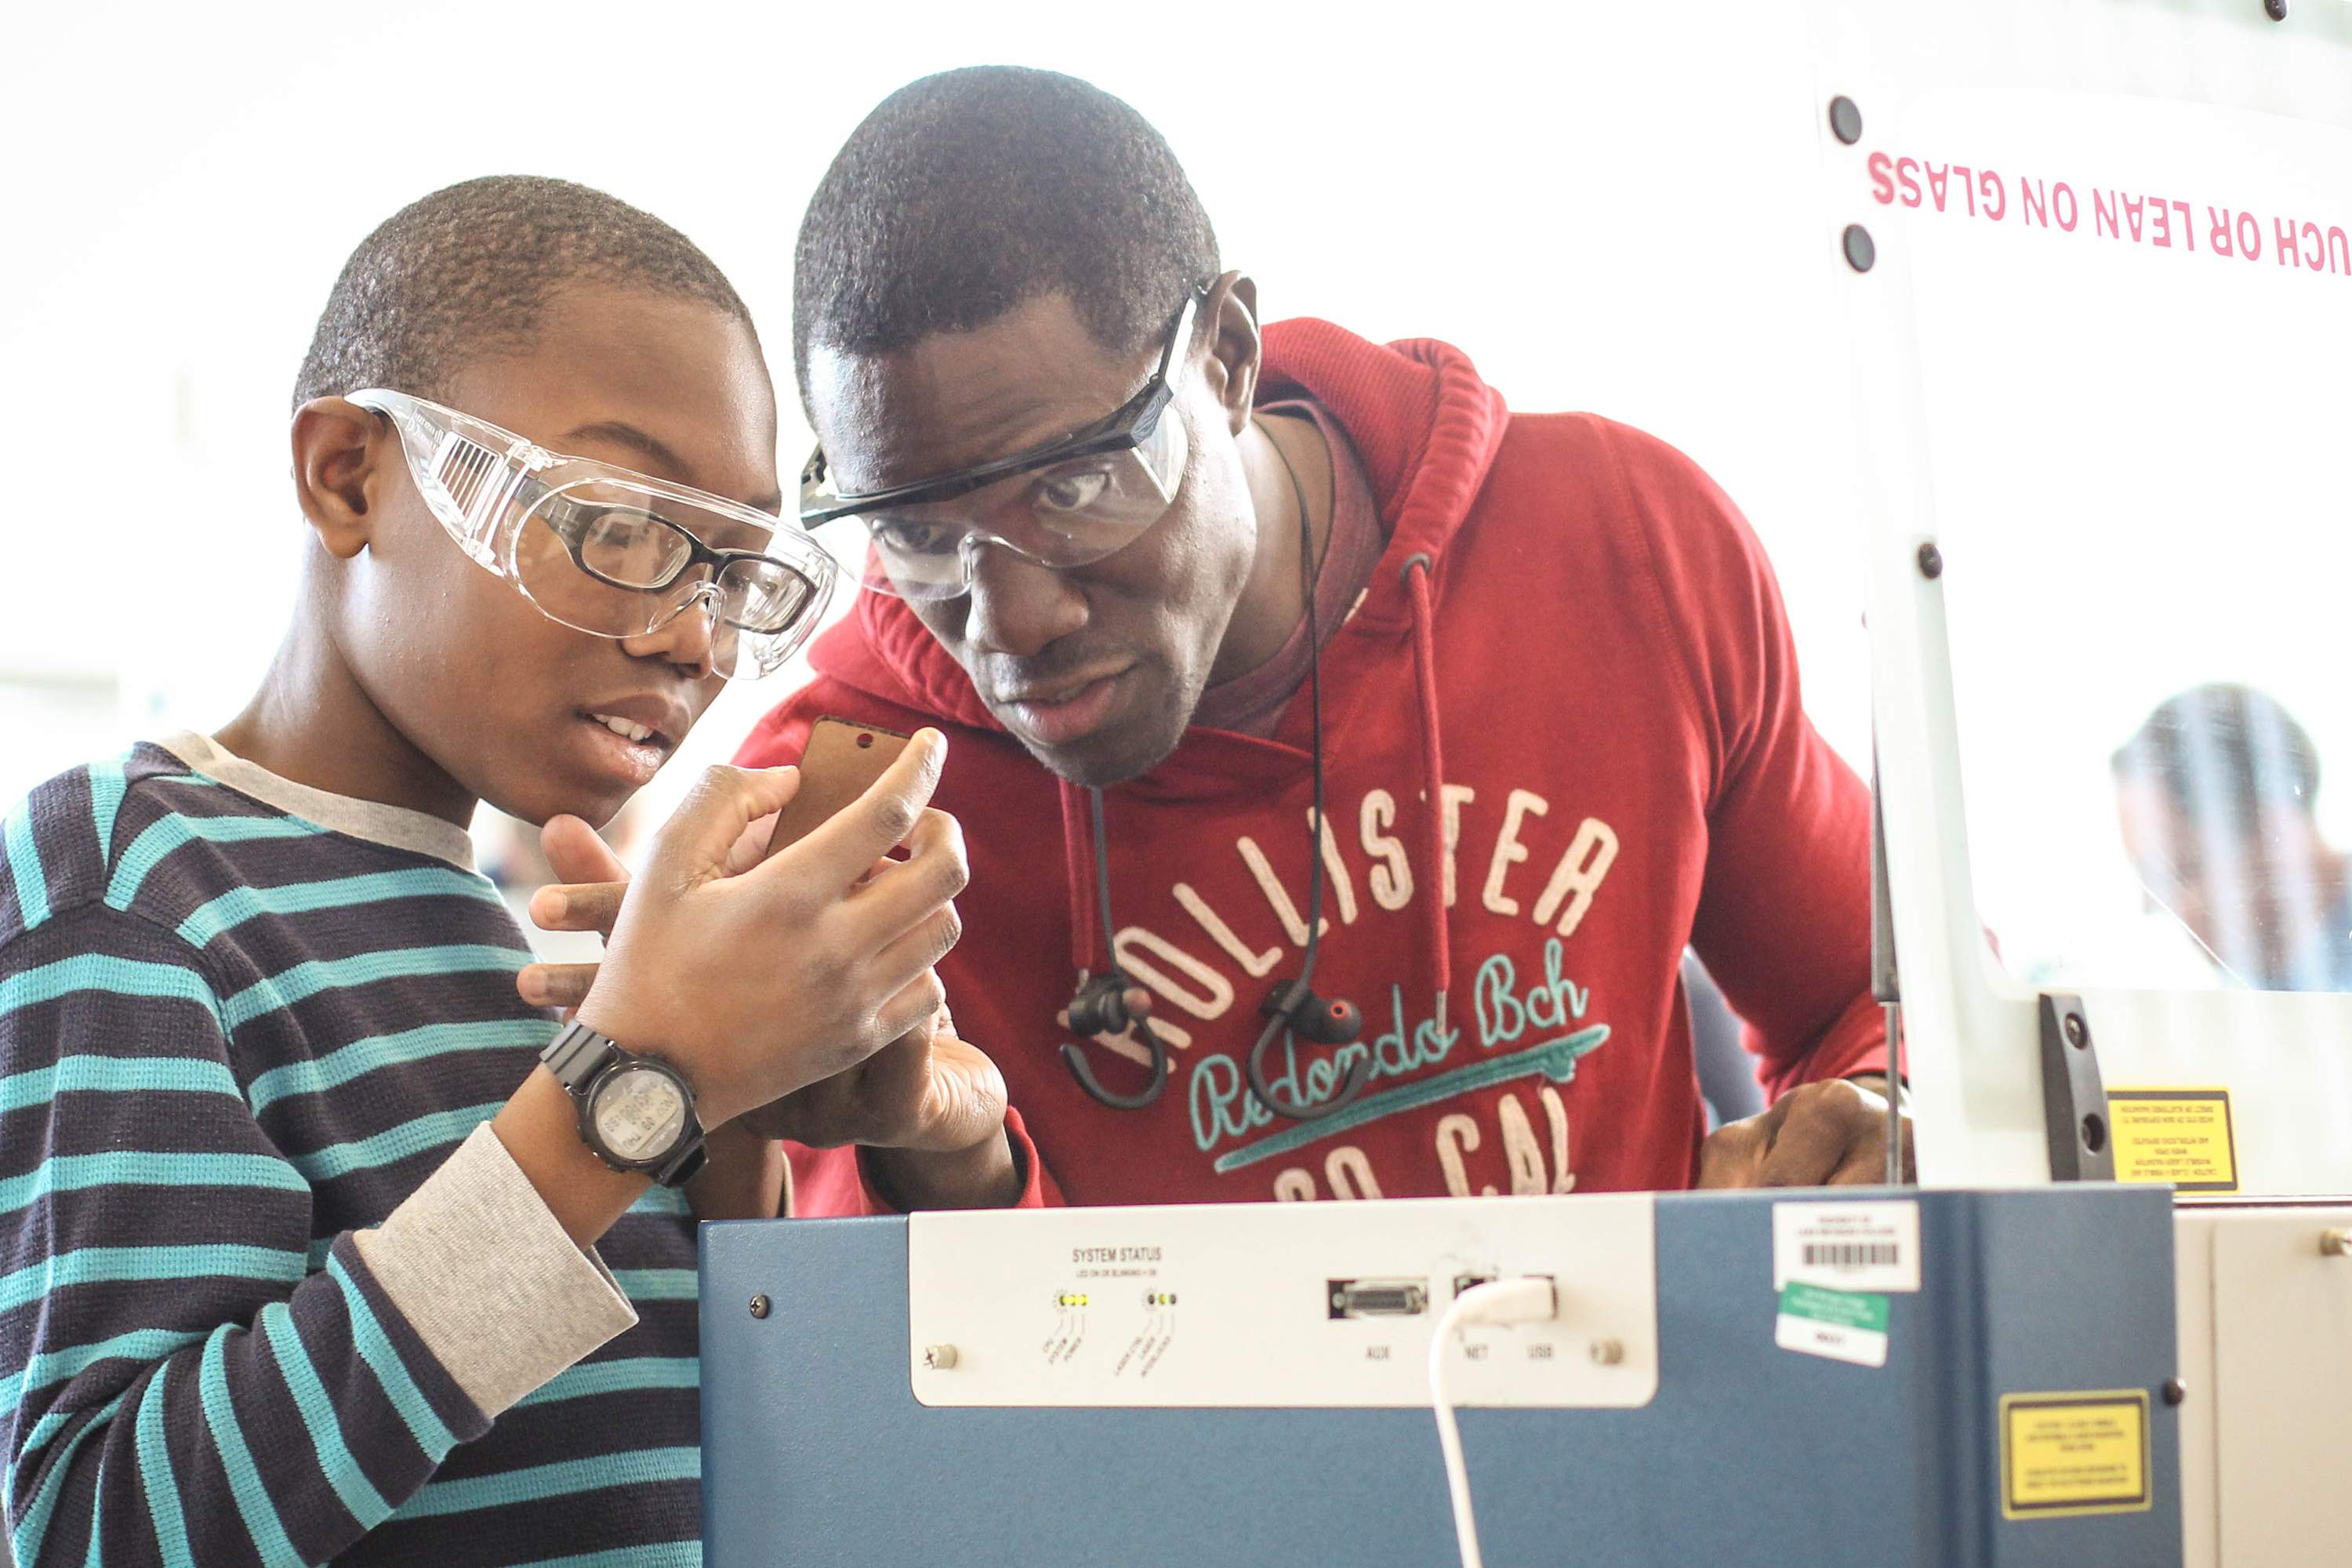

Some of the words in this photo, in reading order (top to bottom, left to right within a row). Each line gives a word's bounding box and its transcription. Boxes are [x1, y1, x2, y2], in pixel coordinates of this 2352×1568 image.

[1868, 152, 2005, 220] GLASS
[2021, 177, 2078, 232] ON
[2093, 188, 2194, 251] LEAN
[2209, 207, 2260, 260] OR
[2274, 218, 2350, 275] UCH
[1189, 983, 1460, 1151] Redondo
[1474, 938, 1588, 1047] Bch
[1436, 1087, 1576, 1196] CAL
[1072, 1248, 1116, 1263] SYSTEM
[1120, 1247, 1162, 1261] STATUS
[1366, 1345, 1390, 1360] AUX
[1464, 1343, 1488, 1359] NET
[1527, 1343, 1554, 1359] USB
